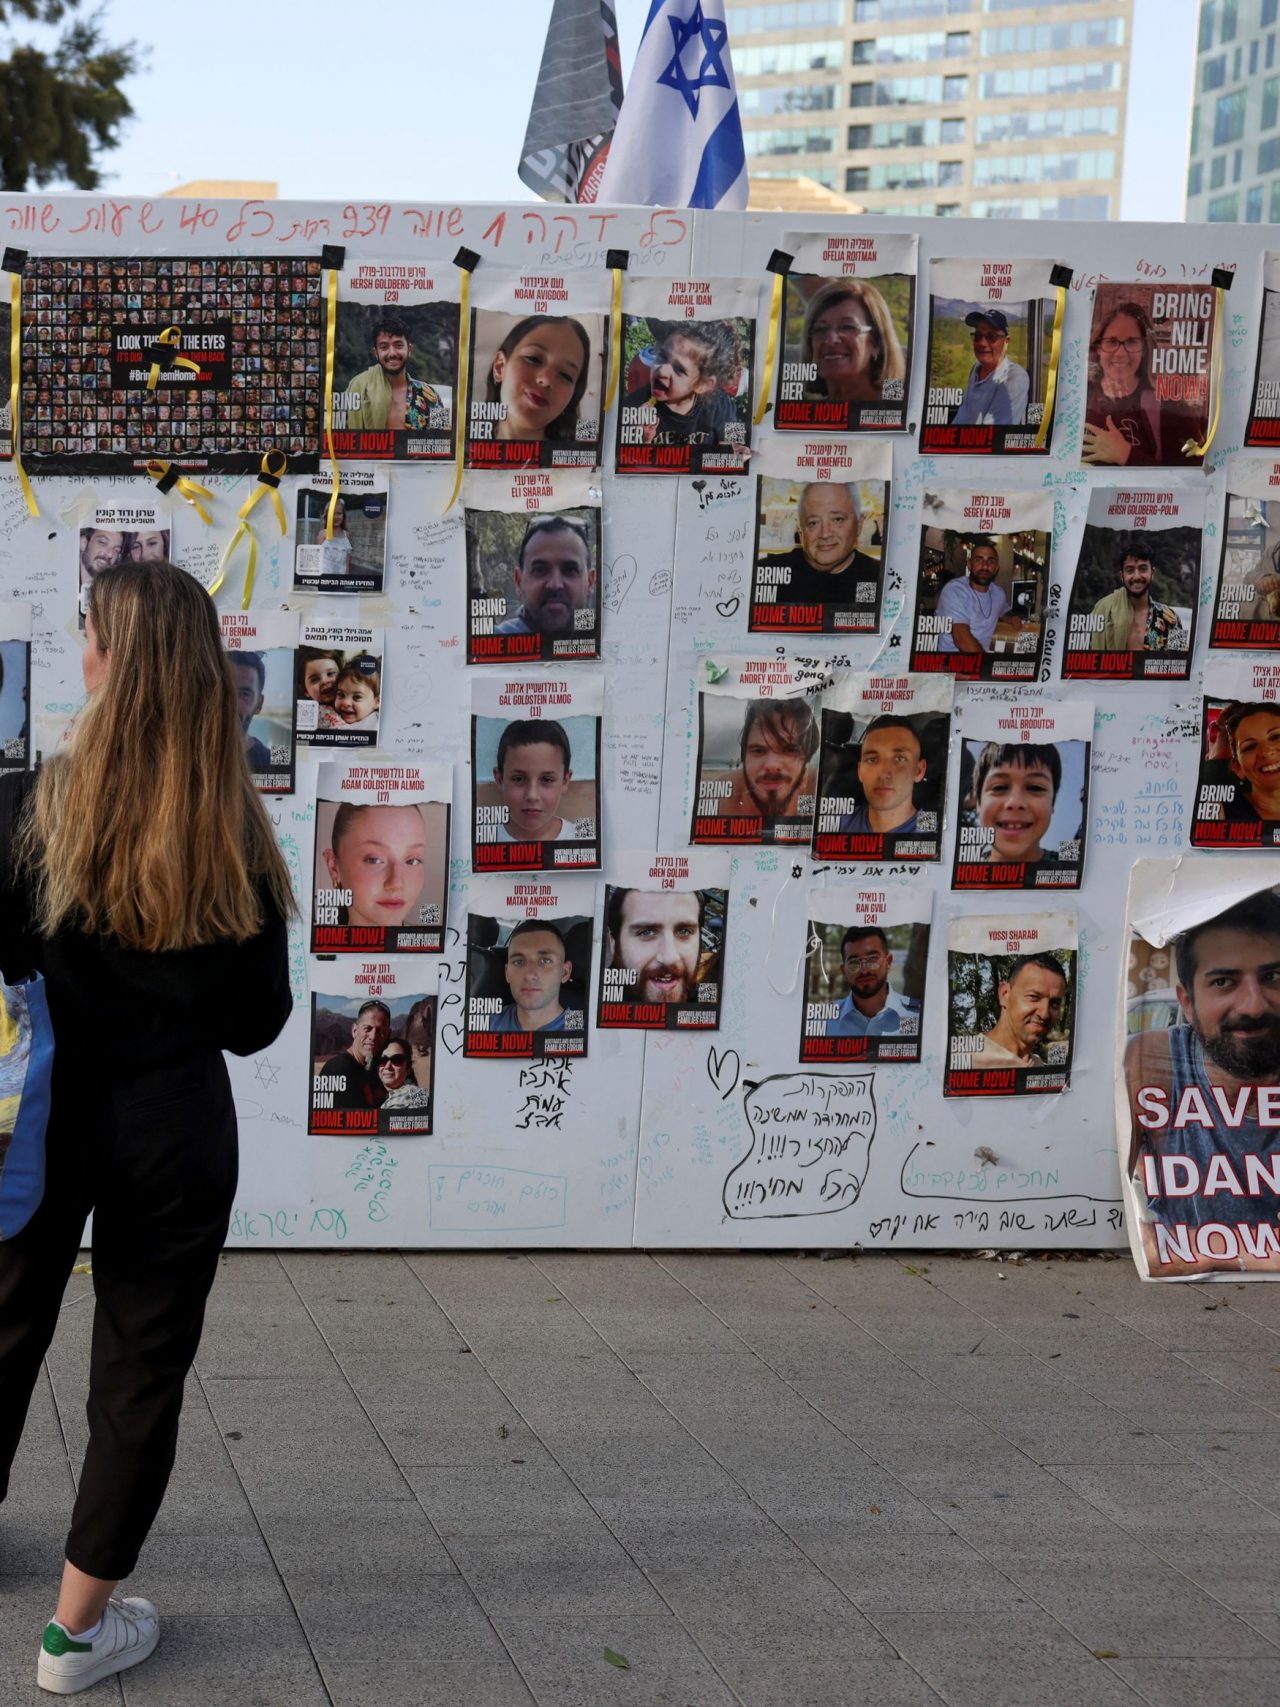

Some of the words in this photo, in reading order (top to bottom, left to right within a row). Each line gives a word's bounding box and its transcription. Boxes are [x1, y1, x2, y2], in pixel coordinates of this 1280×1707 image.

[522, 212, 618, 253] דקה
[822, 250, 845, 262] OFELIA
[846, 250, 878, 262] ROITMAN
[349, 278, 374, 290] HERSH
[374, 278, 434, 290] GOLDBERG-POLIN
[980, 276, 996, 287] LUIS
[997, 276, 1012, 287] HAR
[514, 288, 535, 300] NOAM
[536, 289, 569, 301] AVIGDORI
[988, 287, 1003, 299] (70)
[667, 294, 694, 306] AVIGAIL
[695, 294, 713, 306] IDAN
[1152, 293, 1212, 319] BRING
[1171, 321, 1210, 346] NILI
[117, 335, 141, 350] LOOK
[183, 334, 202, 349] THE
[203, 334, 226, 350] EYES
[1152, 349, 1208, 374] HOME
[782, 363, 818, 381] BRING
[781, 382, 804, 400] HER
[1156, 375, 1207, 401] NOW!
[779, 403, 812, 421] HOME
[814, 402, 849, 422] NOW!
[796, 456, 815, 467] DENIL
[816, 456, 853, 468] KIMENFELD
[511, 487, 522, 498] ELI
[522, 485, 554, 498] SHARABI
[96, 509, 116, 517] קוניו
[117, 509, 134, 517] ודוד
[136, 509, 155, 518] שרון
[963, 506, 984, 518] SEGEV
[985, 507, 1012, 519] KALFON
[304, 633, 328, 641] חמאס
[329, 634, 344, 642] בידי
[345, 635, 373, 643] חטופות
[739, 673, 766, 684] ANDREY
[767, 673, 794, 684] KOZLOV
[998, 718, 1018, 730] YUVAL
[1019, 718, 1055, 730] BRODUTCH
[340, 779, 362, 790] AGAM
[362, 779, 400, 791] GOLDSTEIN
[400, 779, 425, 791] ALMOG
[648, 867, 666, 878] OREN
[666, 867, 690, 878] GOLDIN
[506, 895, 529, 906] MATAN
[529, 895, 558, 906] ANGREST
[855, 903, 870, 913] RAN
[870, 903, 887, 913] GVILI
[988, 930, 1008, 941] YOSSI
[1008, 929, 1039, 941] SHARABI
[354, 974, 376, 985] RONEN
[376, 974, 396, 985] ANGEL
[950, 1035, 985, 1054] BRING
[949, 1053, 972, 1070] HIM
[948, 1071, 981, 1089] HOME
[983, 1069, 1016, 1088] NOW!
[1136, 1085, 1280, 1130] SAVE
[1143, 1153, 1280, 1199] IDAN
